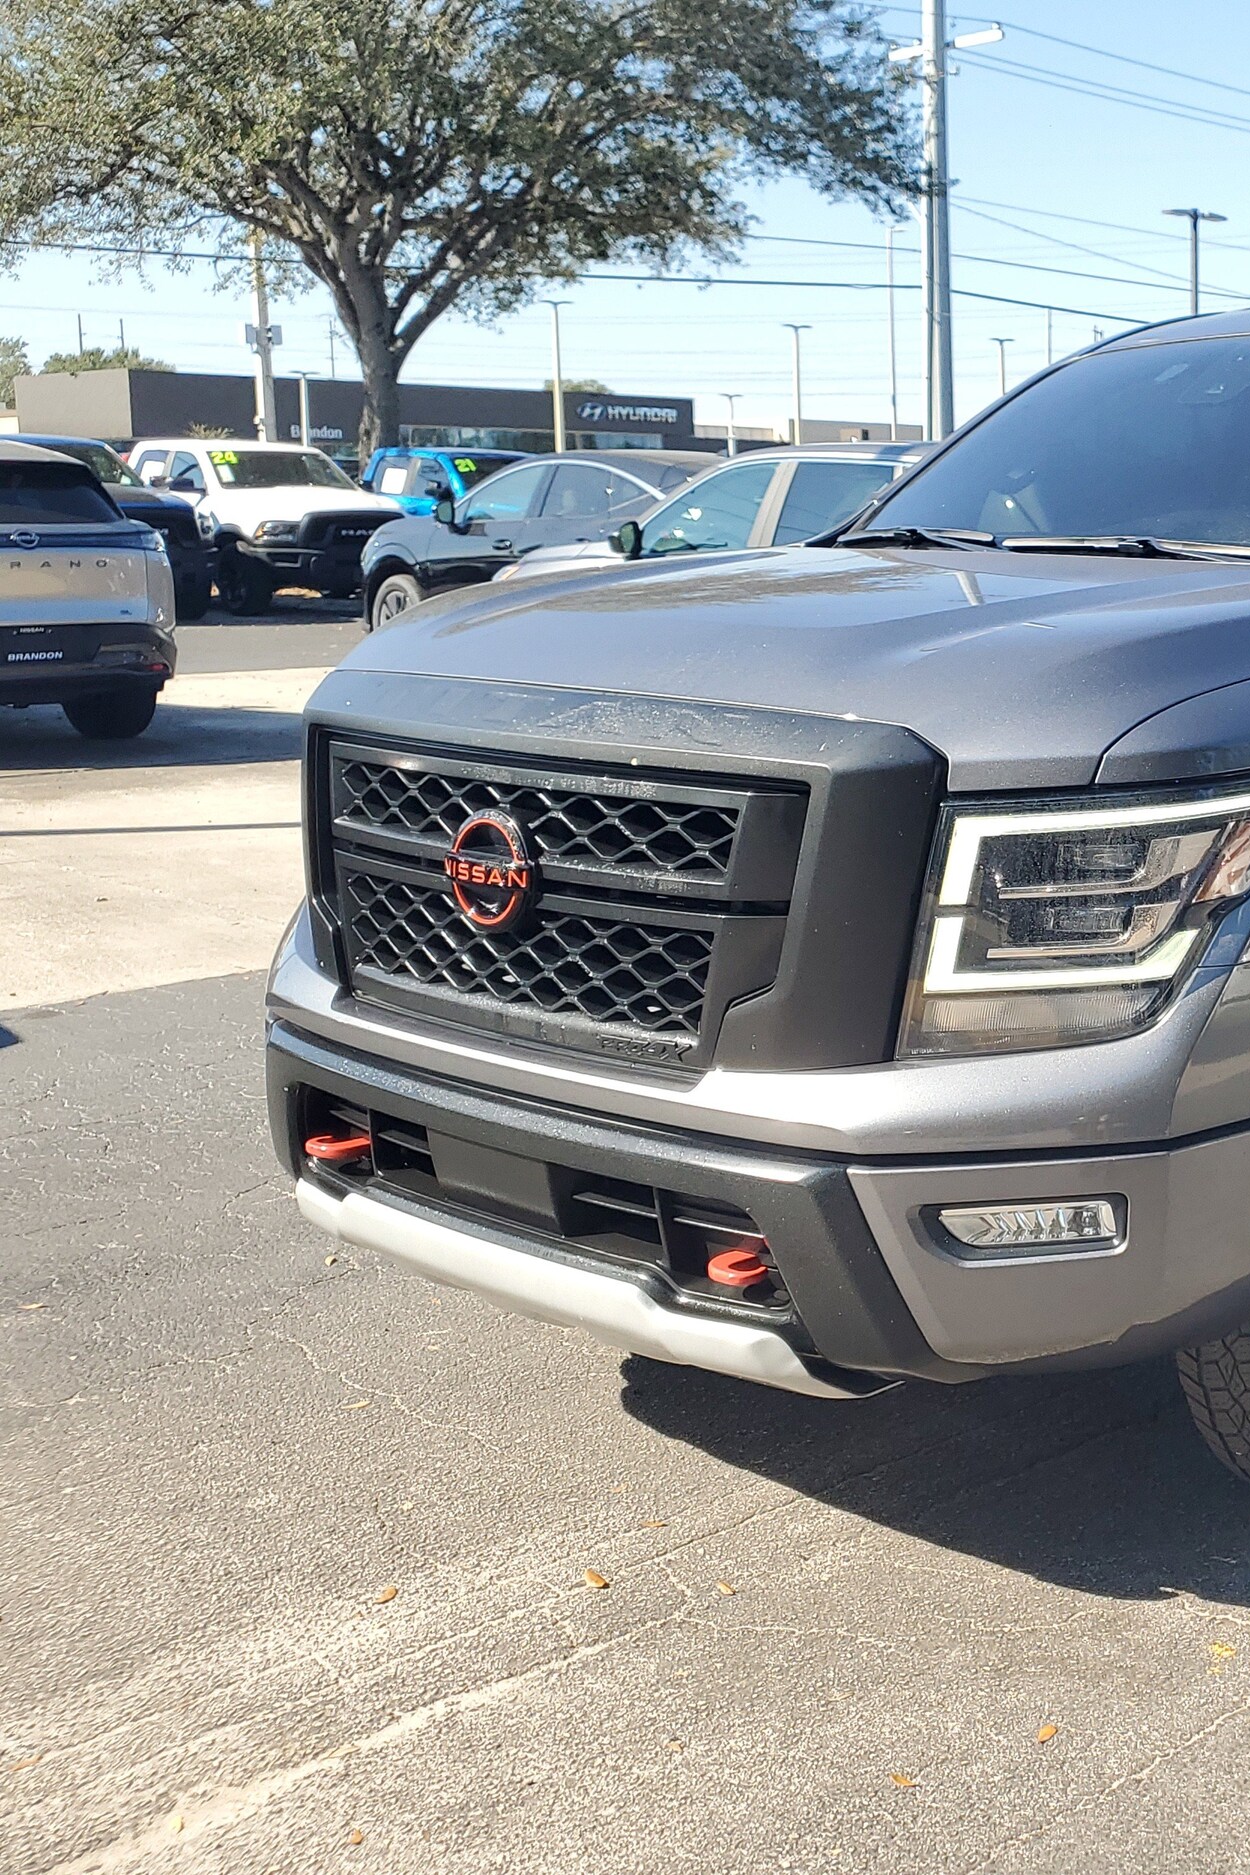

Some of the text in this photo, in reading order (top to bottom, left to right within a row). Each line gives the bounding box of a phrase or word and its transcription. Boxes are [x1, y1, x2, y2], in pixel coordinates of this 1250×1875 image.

[607, 405, 679, 424] HYUNDAI
[290, 424, 343, 439] Bndon
[210, 451, 239, 465] 24
[454, 458, 477, 473] 21
[7, 651, 63, 662] BRANDON
[444, 857, 528, 889] NISSAN
